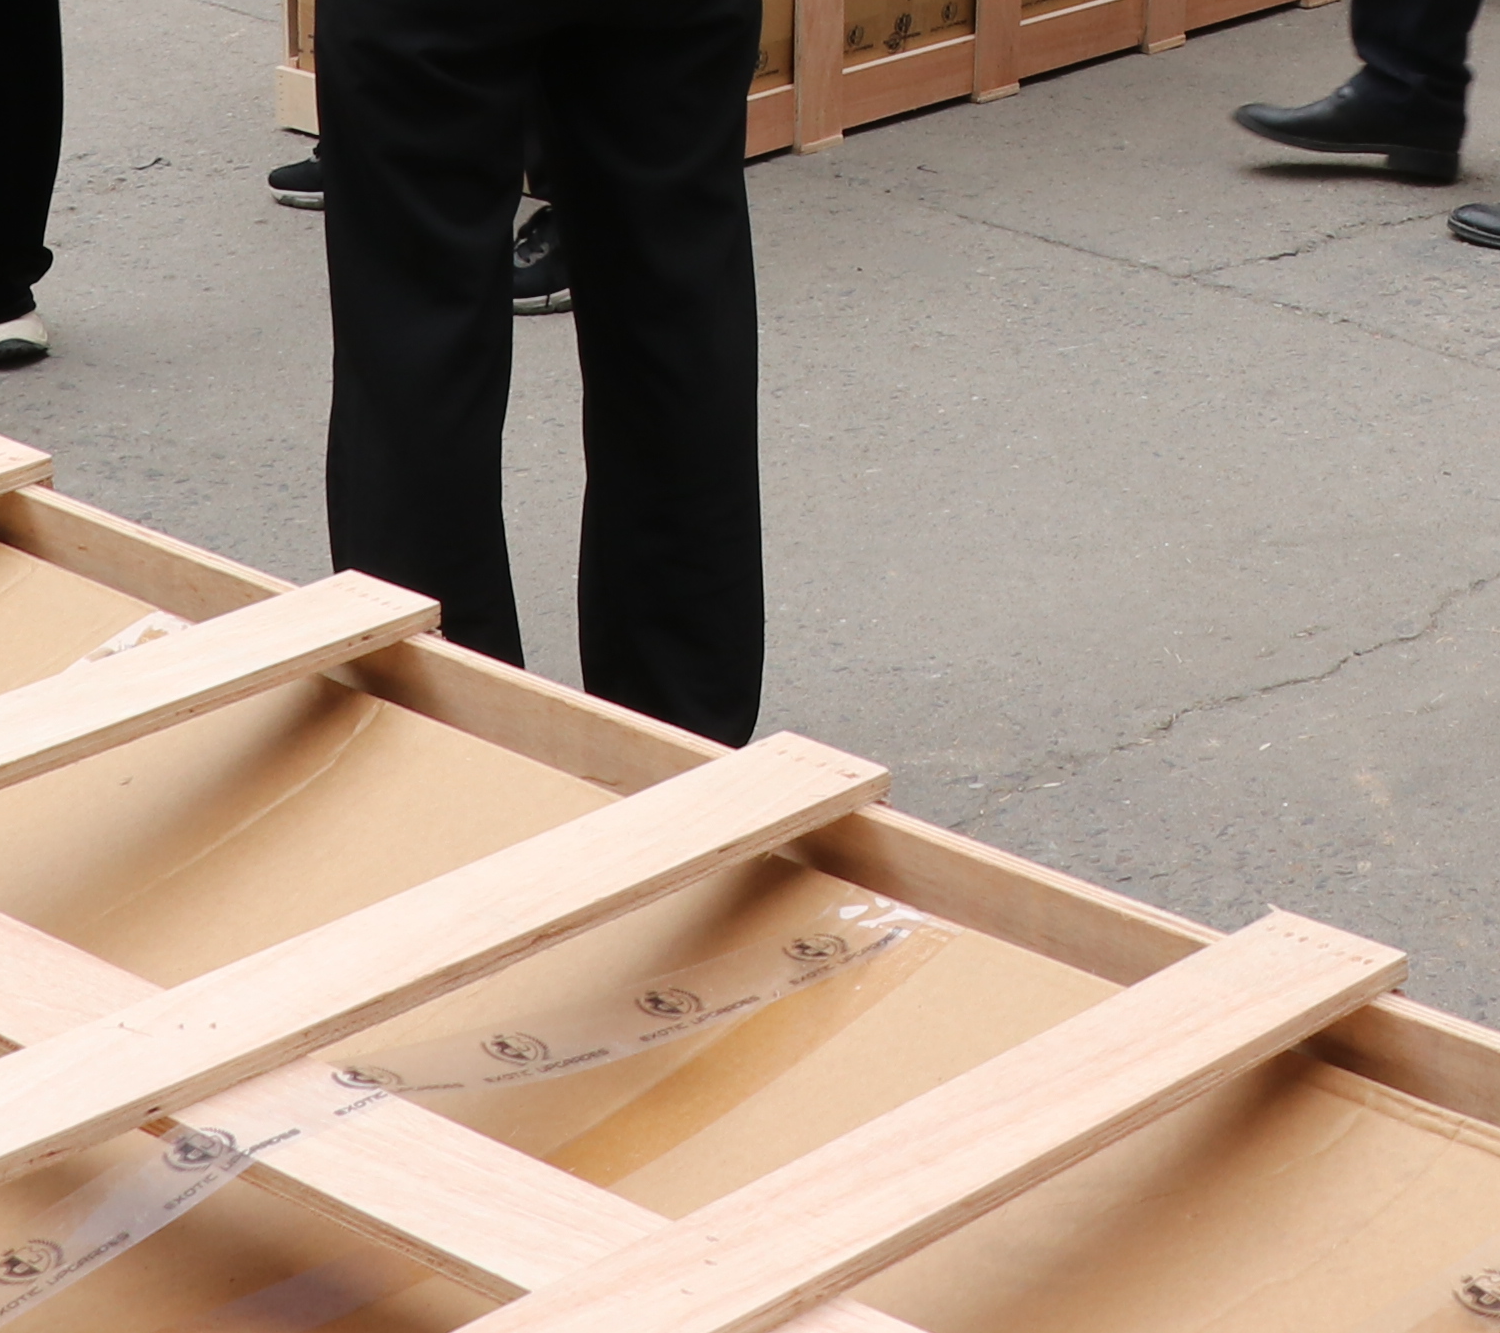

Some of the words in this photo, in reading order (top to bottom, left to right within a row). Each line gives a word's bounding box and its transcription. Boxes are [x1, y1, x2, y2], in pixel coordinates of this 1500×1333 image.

[638, 1021, 689, 1043] EXOTIC
[482, 1068, 534, 1085] EXOTIC
[333, 1089, 390, 1118] EXOTIC
[162, 1170, 220, 1212] EXOTIC
